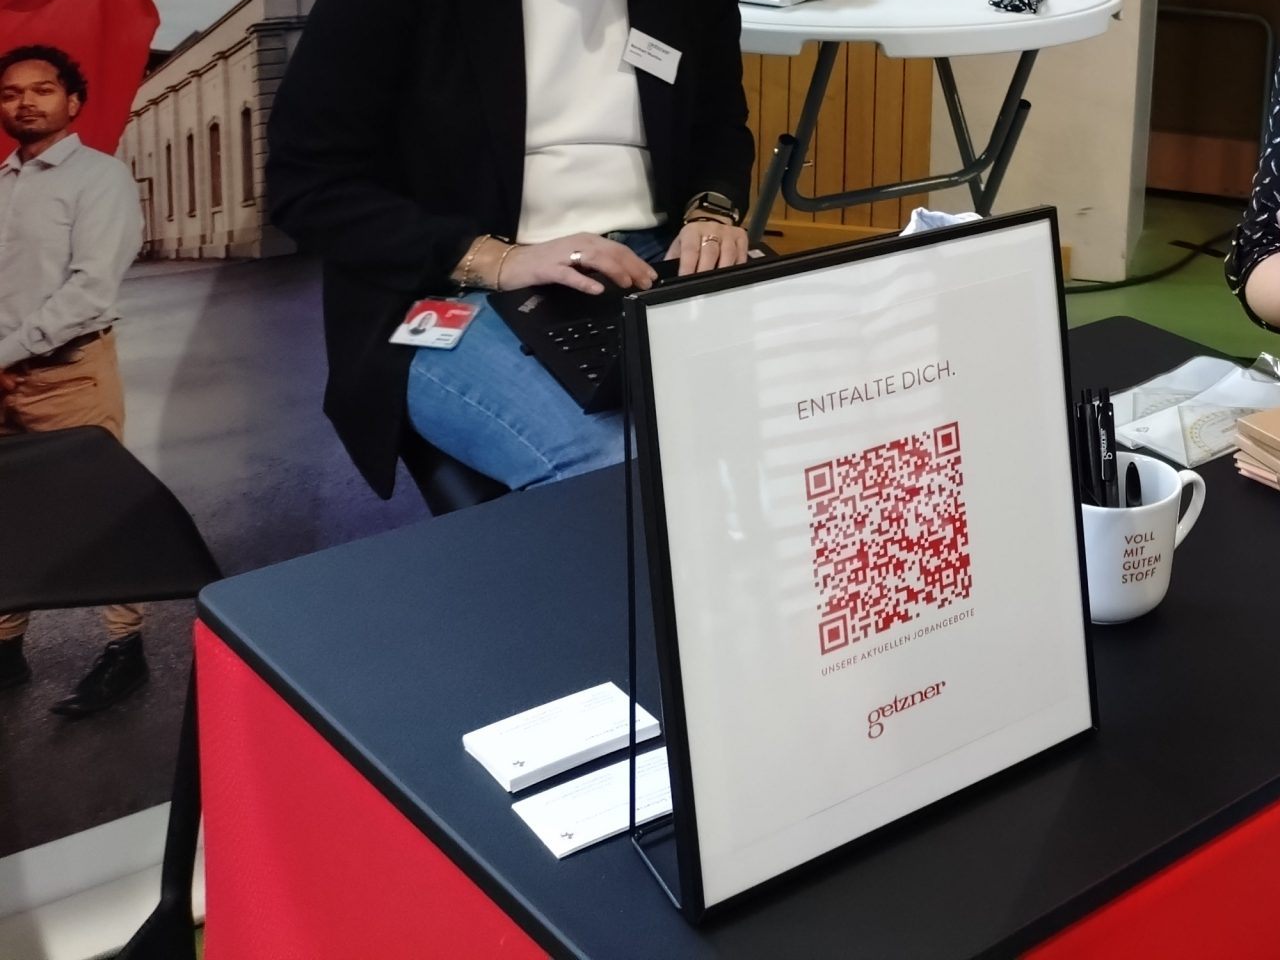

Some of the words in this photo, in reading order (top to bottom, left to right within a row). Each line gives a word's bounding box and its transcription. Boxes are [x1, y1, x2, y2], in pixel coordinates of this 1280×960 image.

[797, 376, 896, 420] ENTFALTE
[902, 360, 956, 390] DICH.
[1124, 531, 1155, 545] VOLL
[1123, 546, 1145, 558] MIT
[1122, 553, 1161, 571] GUTEM
[1121, 567, 1156, 584] STOFF
[821, 655, 858, 677] UNSERE
[860, 634, 911, 661] AKTUELLEN
[911, 607, 976, 641] JOBANGEBOTE
[867, 680, 946, 739] getzner
